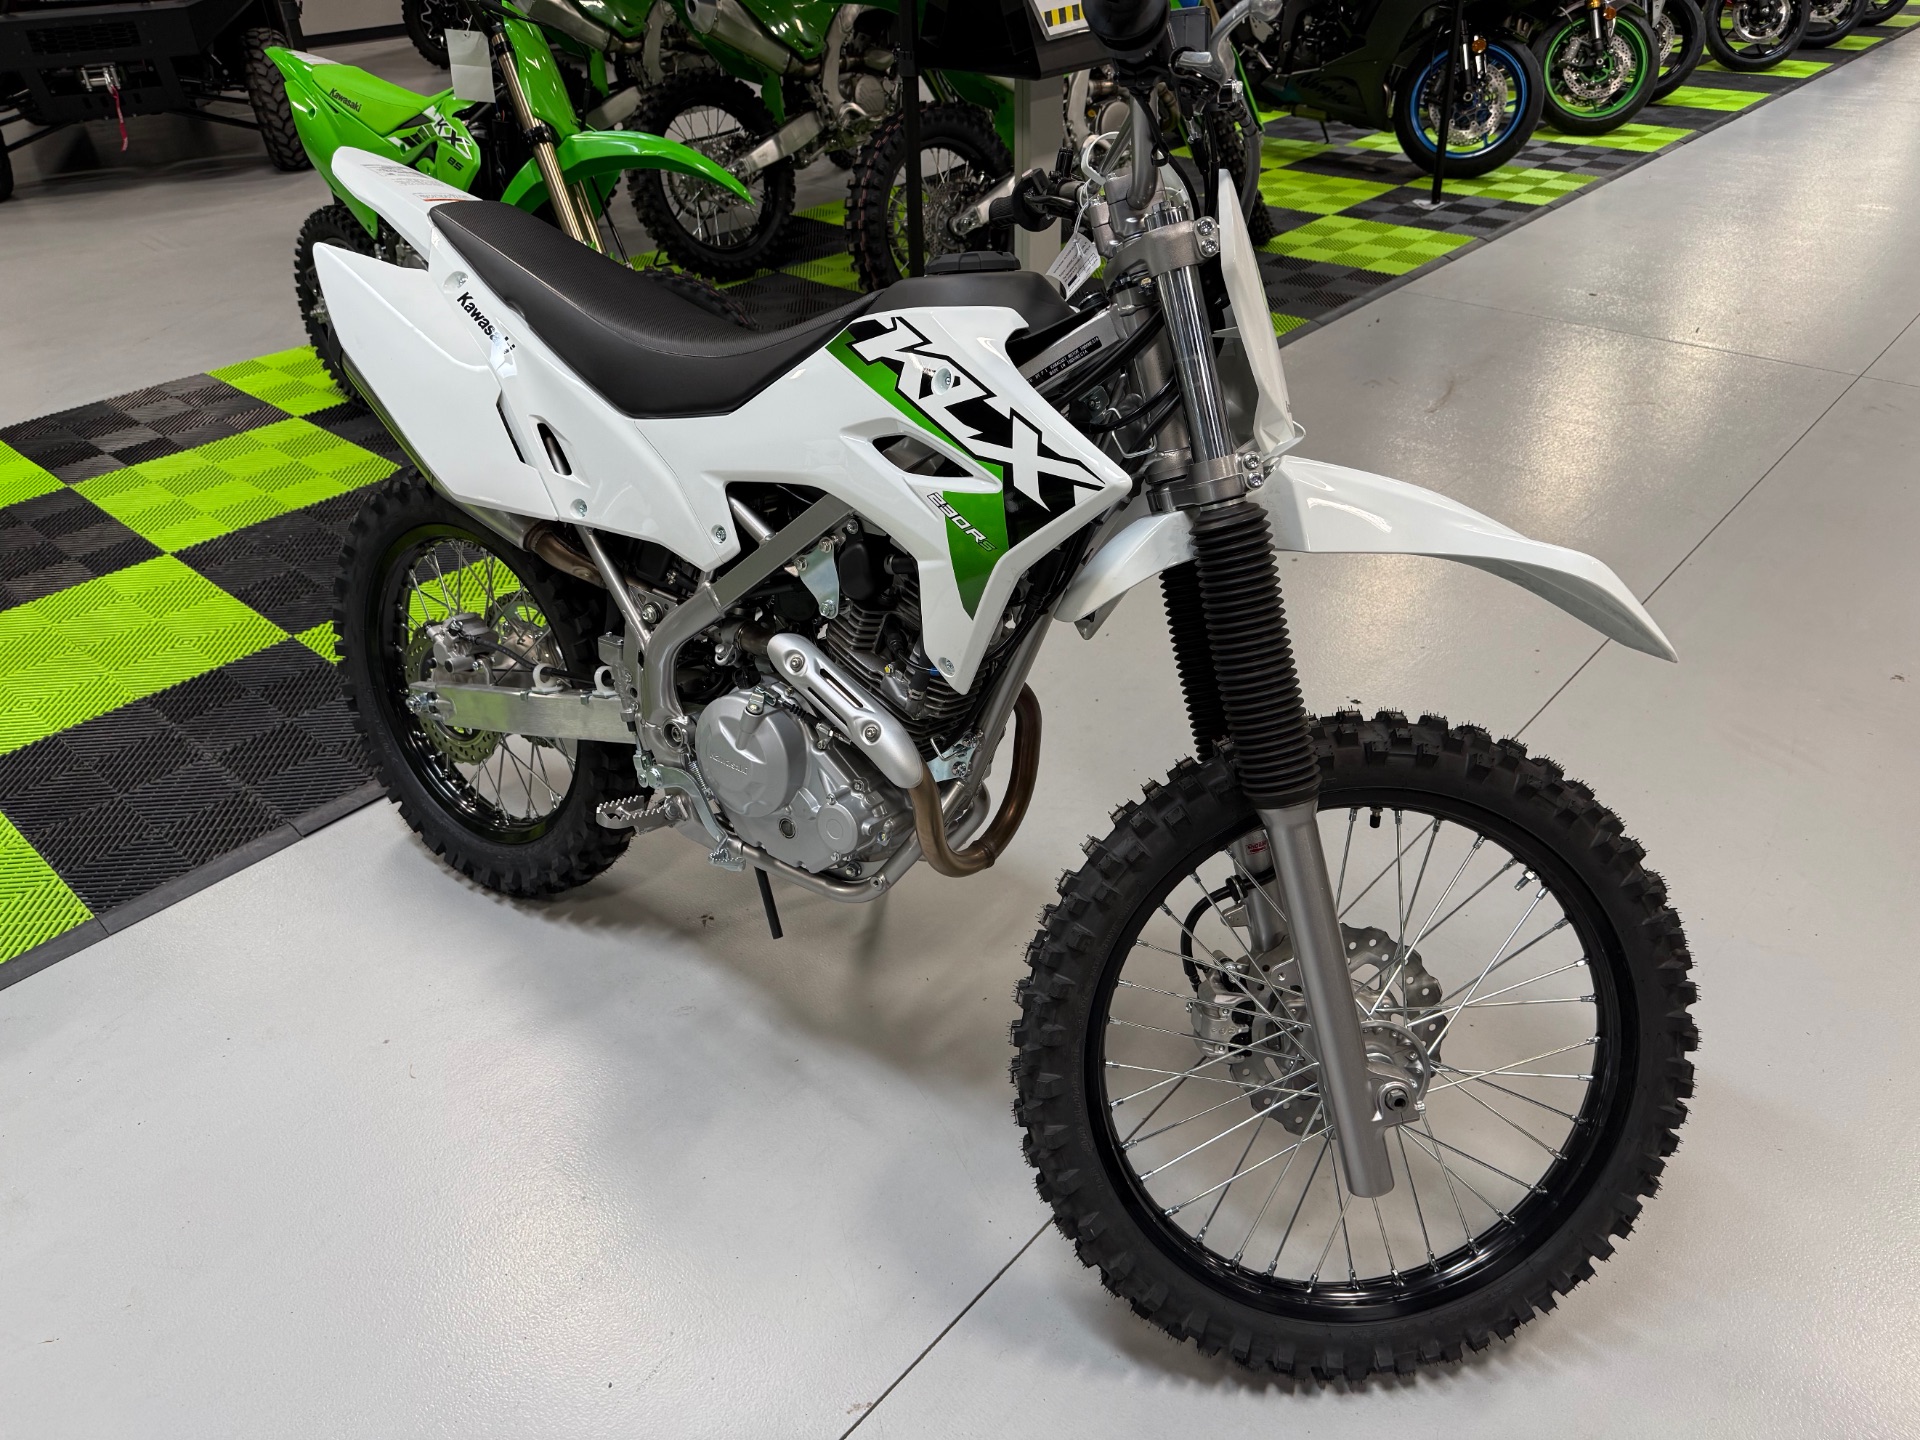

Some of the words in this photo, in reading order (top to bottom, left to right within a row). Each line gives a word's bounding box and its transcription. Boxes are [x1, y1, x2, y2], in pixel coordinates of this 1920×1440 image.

[329, 88, 362, 113] Kawasaki
[432, 114, 473, 160] KX
[447, 156, 464, 172] 85
[845, 316, 1106, 513] KLX
